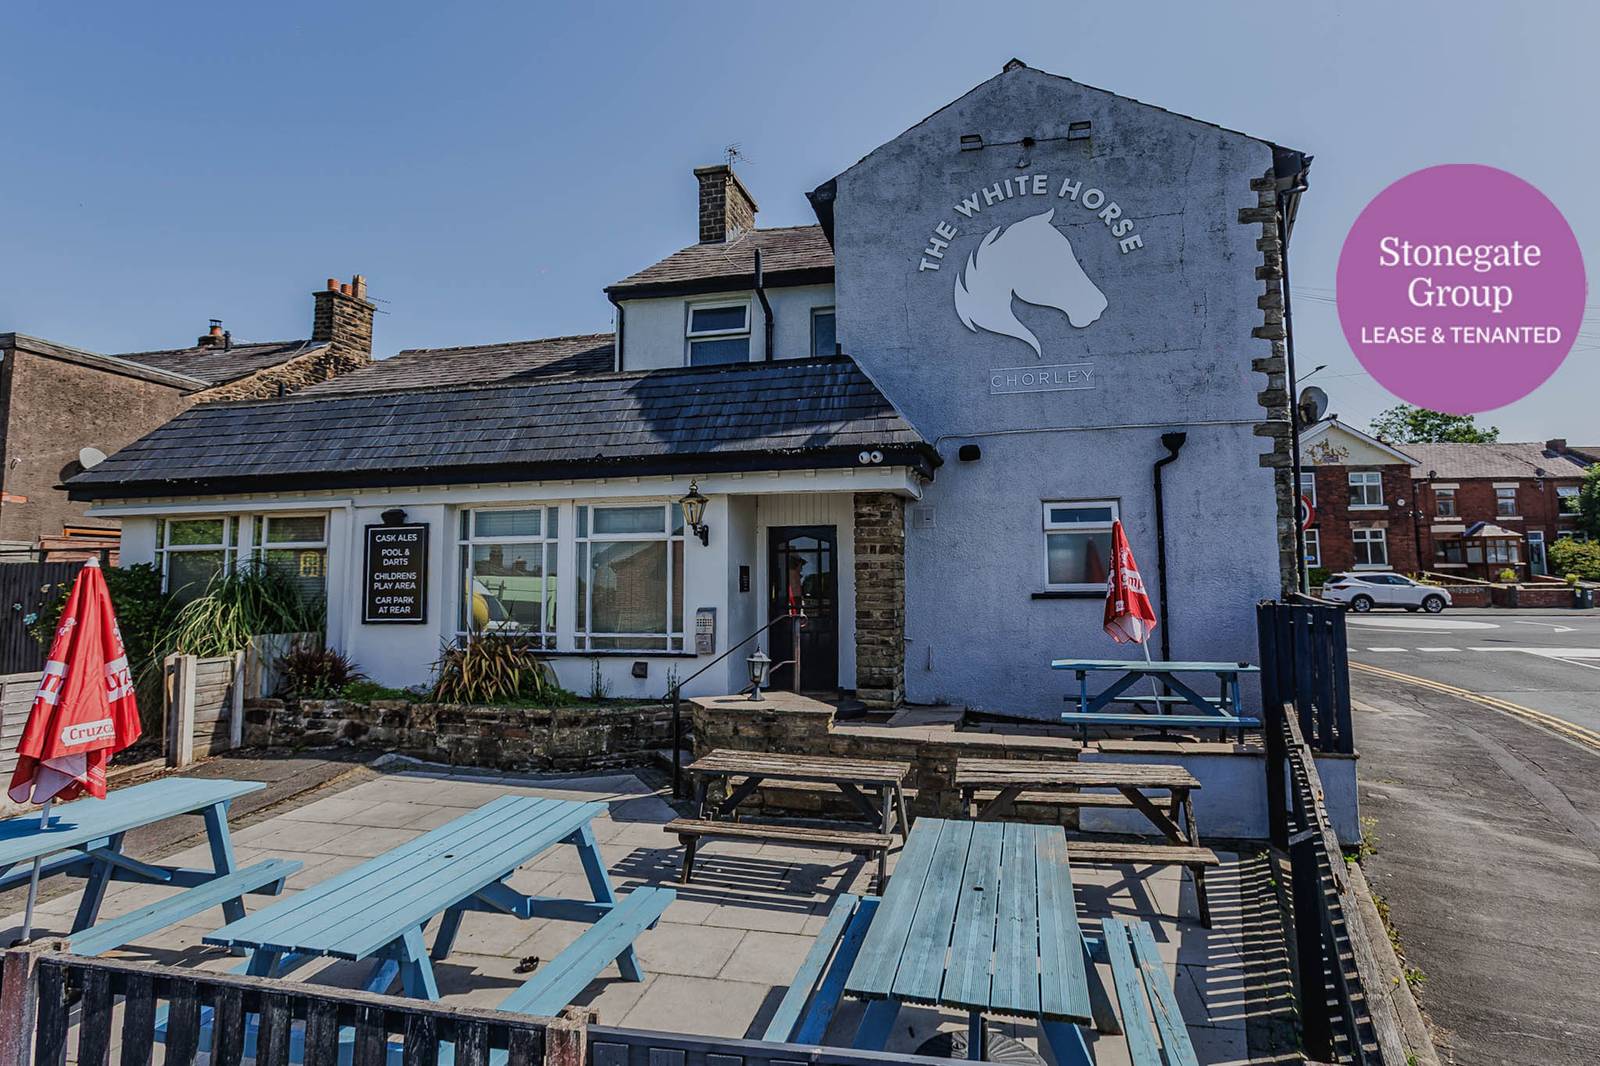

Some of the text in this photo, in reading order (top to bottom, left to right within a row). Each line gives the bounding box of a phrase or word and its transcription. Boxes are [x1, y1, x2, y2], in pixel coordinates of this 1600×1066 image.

[919, 174, 1144, 272] THE WHITE HORSE
[991, 369, 1094, 388] CHORLEY
[375, 533, 418, 542] CASK ALES
[381, 548, 410, 556] POOL &
[383, 558, 408, 566] DARTS
[374, 572, 417, 580] CHILDRENS
[373, 581, 416, 590] PLAY AREA
[375, 596, 414, 604] CAR PARK
[378, 606, 411, 614] AT REAR
